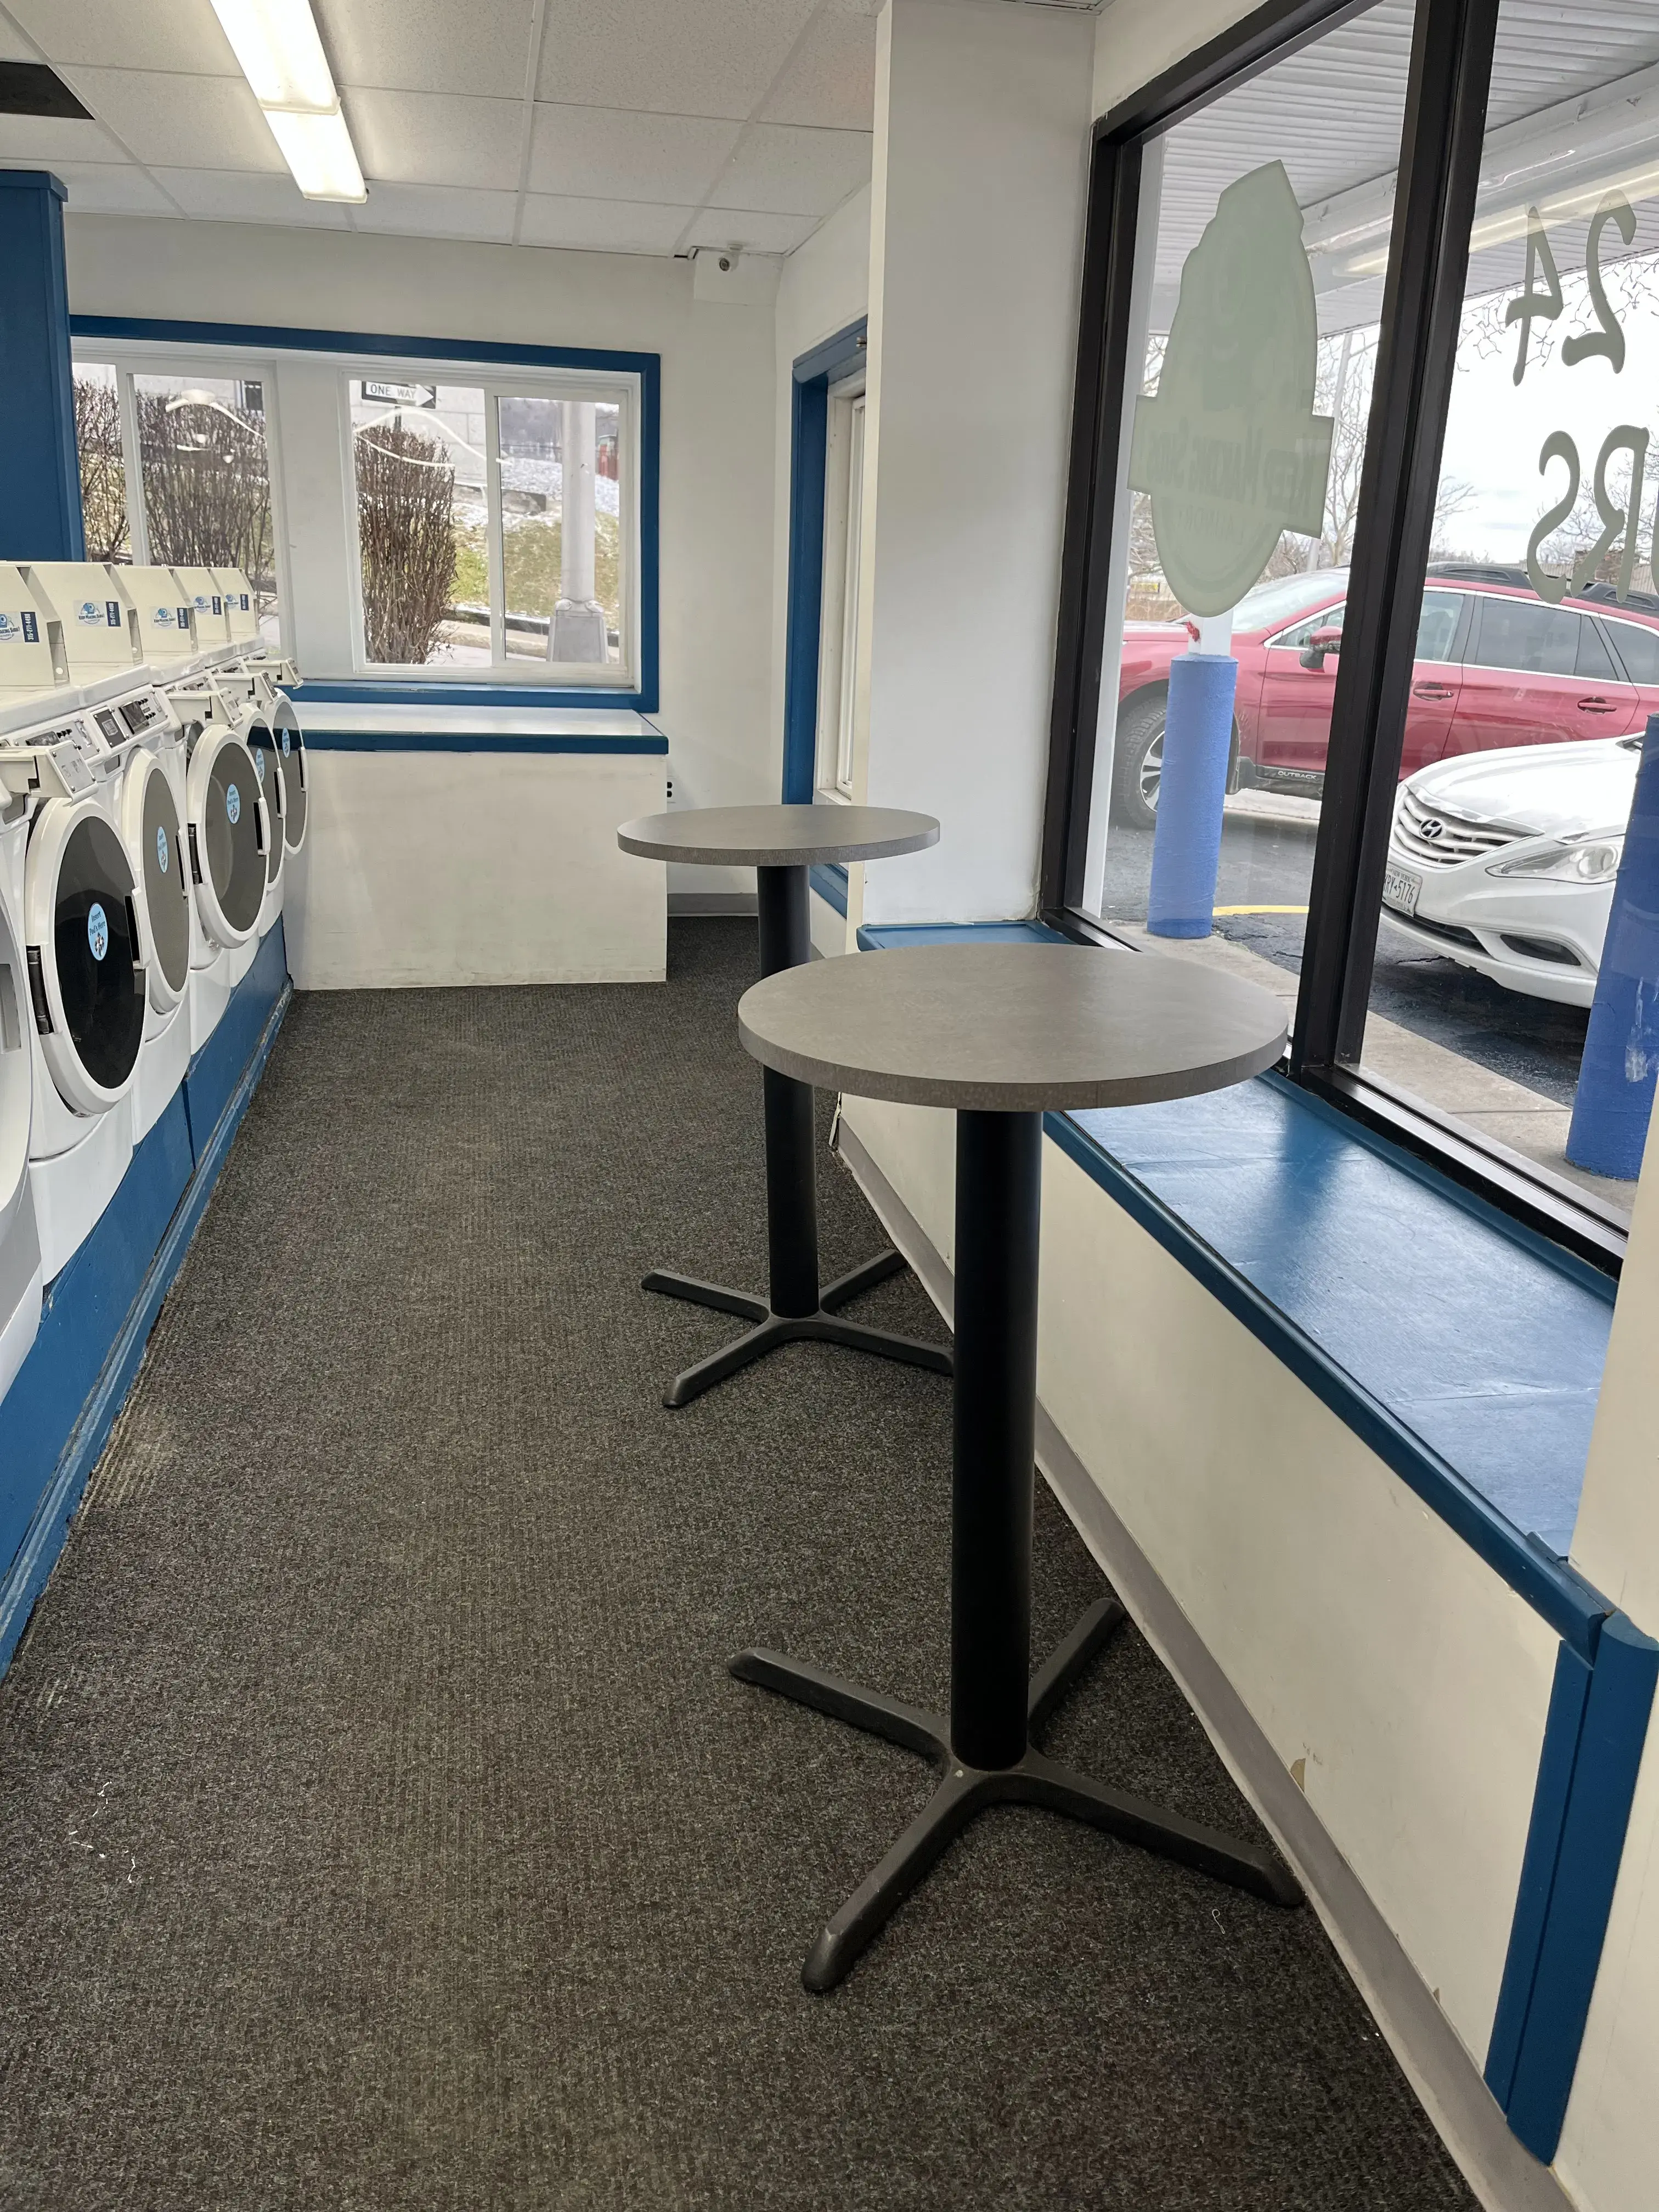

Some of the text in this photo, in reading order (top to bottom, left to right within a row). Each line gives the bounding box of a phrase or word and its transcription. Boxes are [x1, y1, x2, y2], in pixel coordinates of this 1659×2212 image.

[370, 383, 416, 399] ONE WAY
[1277, 771, 1317, 780] OUTBACK
[91, 911, 101, 923] Insert
[98, 921, 106, 931] Here
